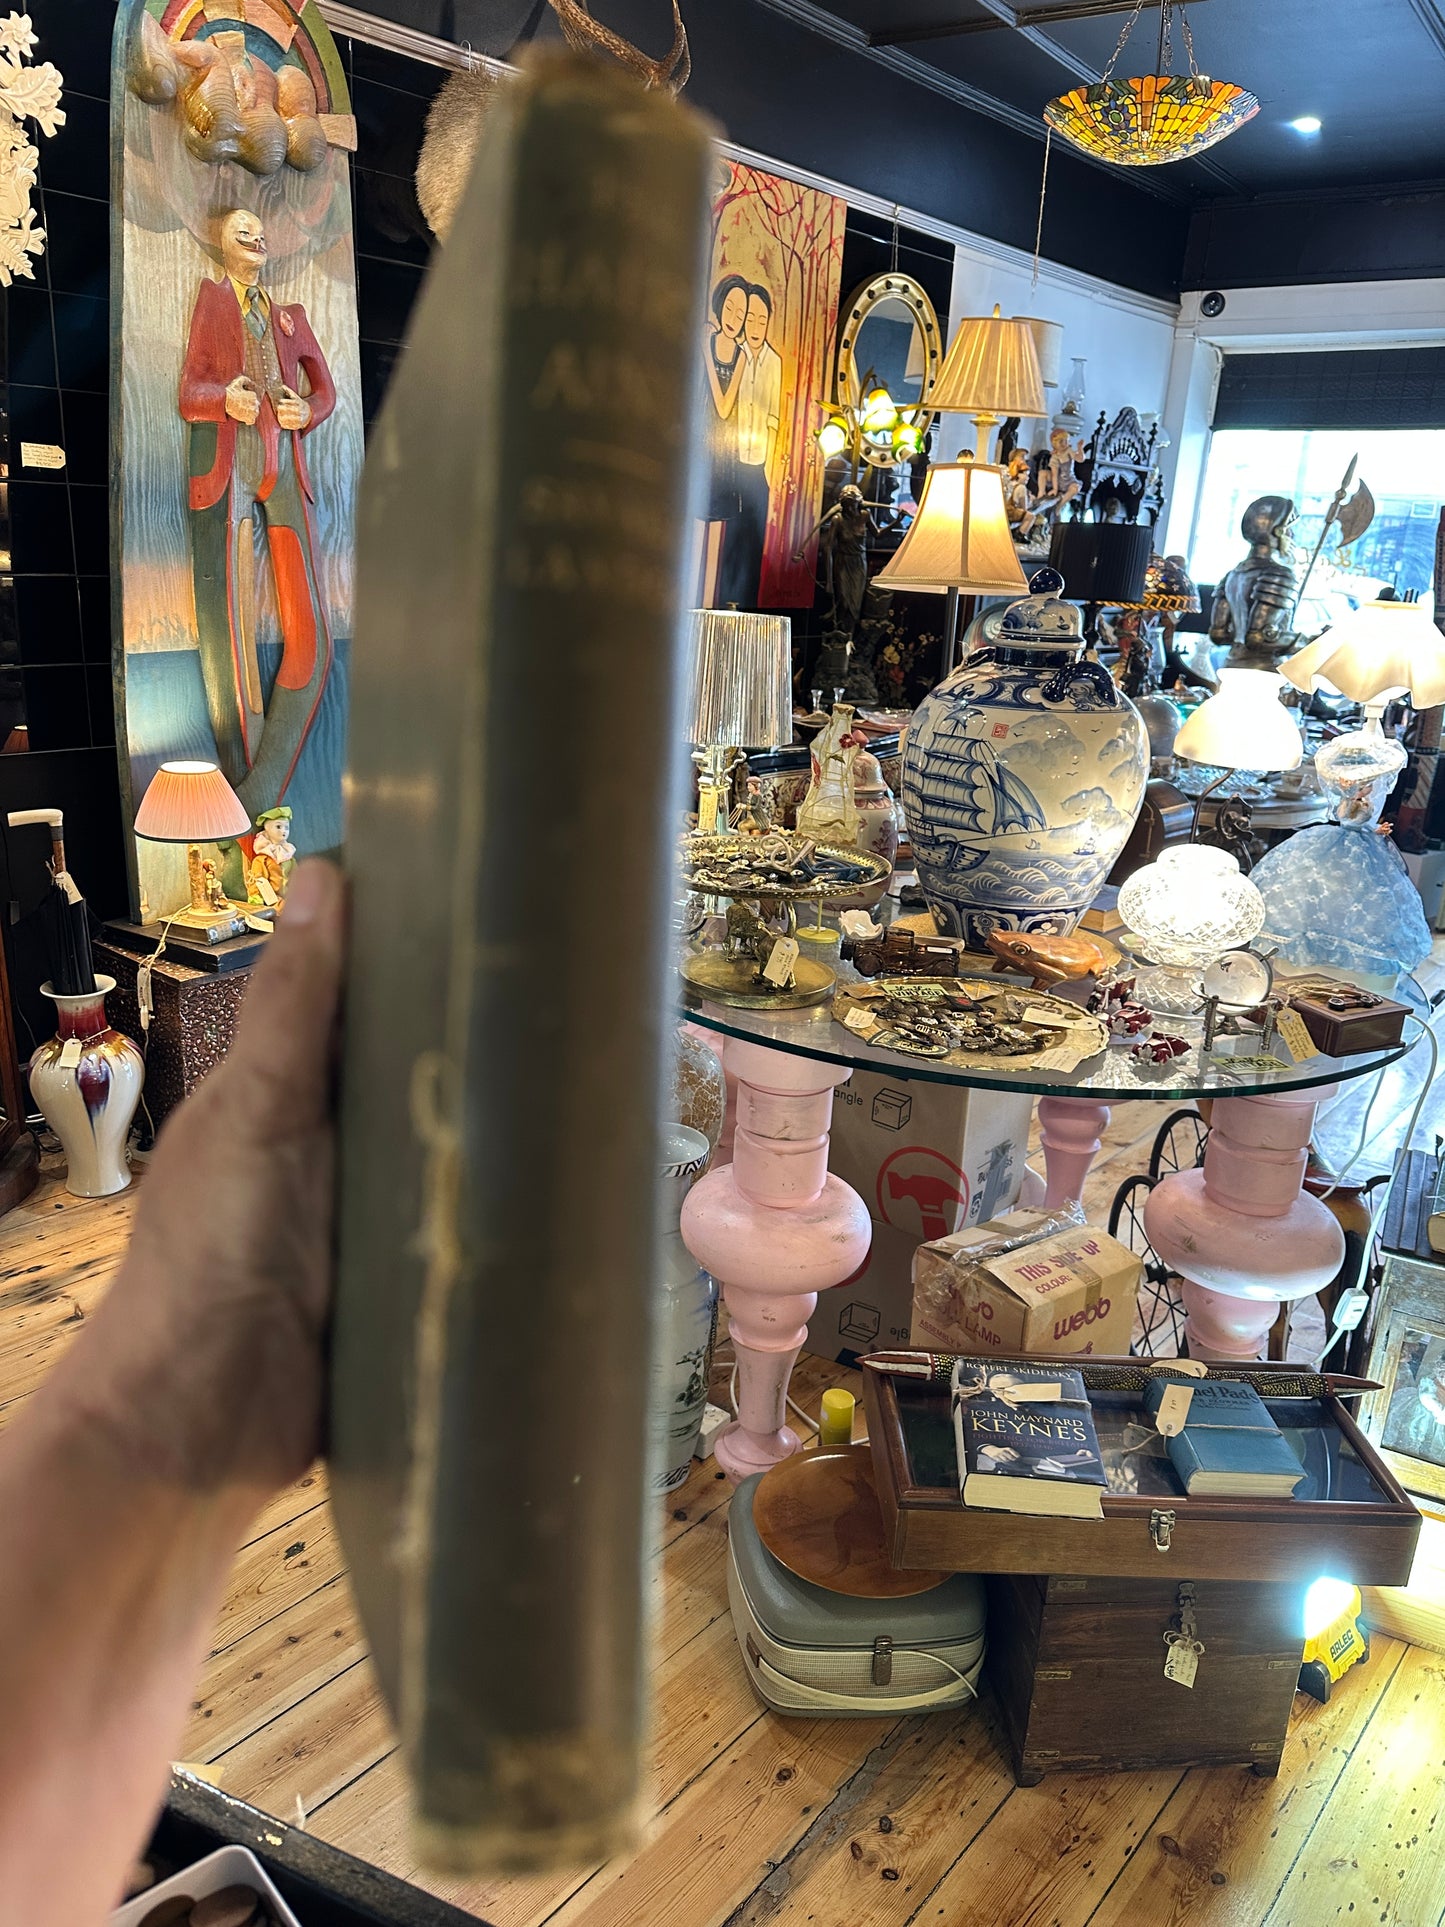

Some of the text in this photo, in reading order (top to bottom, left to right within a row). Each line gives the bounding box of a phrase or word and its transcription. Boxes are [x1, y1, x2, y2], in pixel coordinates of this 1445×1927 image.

[834, 1089, 863, 1105] angle
[1014, 1239, 1101, 1281] THIS SIDE UP
[1035, 1274, 1072, 1294] COLOUR:
[965, 1317, 1001, 1346] LAMP
[966, 1362, 1072, 1378] ROBERT SKIDELSKY
[971, 1409, 1083, 1427] JOHN MAYNARD
[972, 1417, 1087, 1441] KEYNES
[1330, 1629, 1353, 1658] ARLEC
